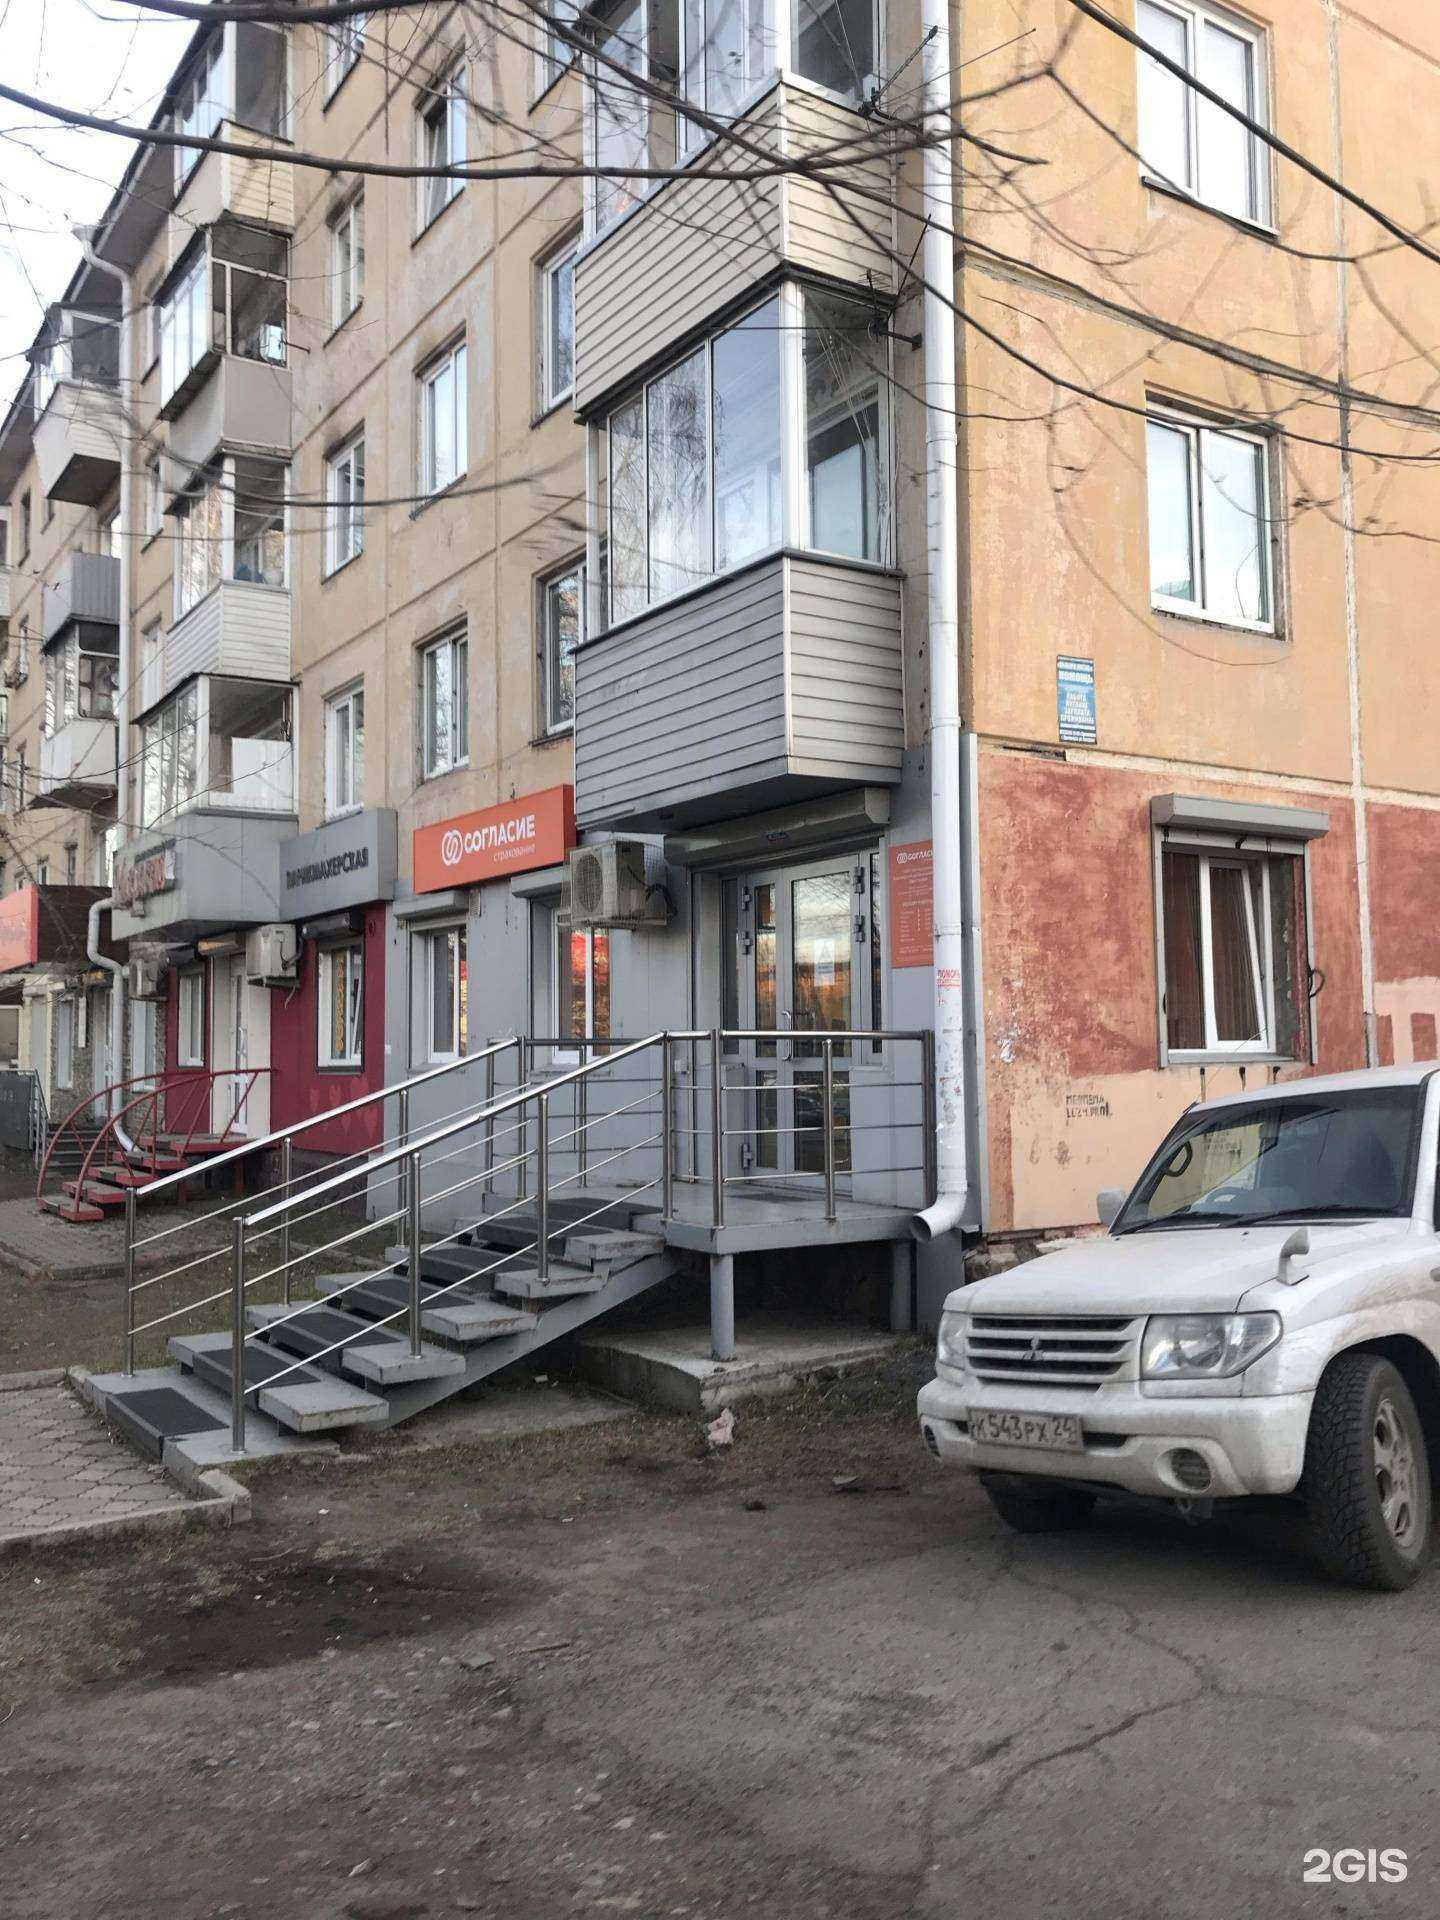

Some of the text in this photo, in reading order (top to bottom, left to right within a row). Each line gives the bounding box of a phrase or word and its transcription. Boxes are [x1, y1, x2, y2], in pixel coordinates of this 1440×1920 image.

[464, 814, 536, 854] СОГЛАСИЕ
[493, 844, 536, 862] страхование
[286, 846, 369, 889] ПАРИКМАХЕРСКАЯ
